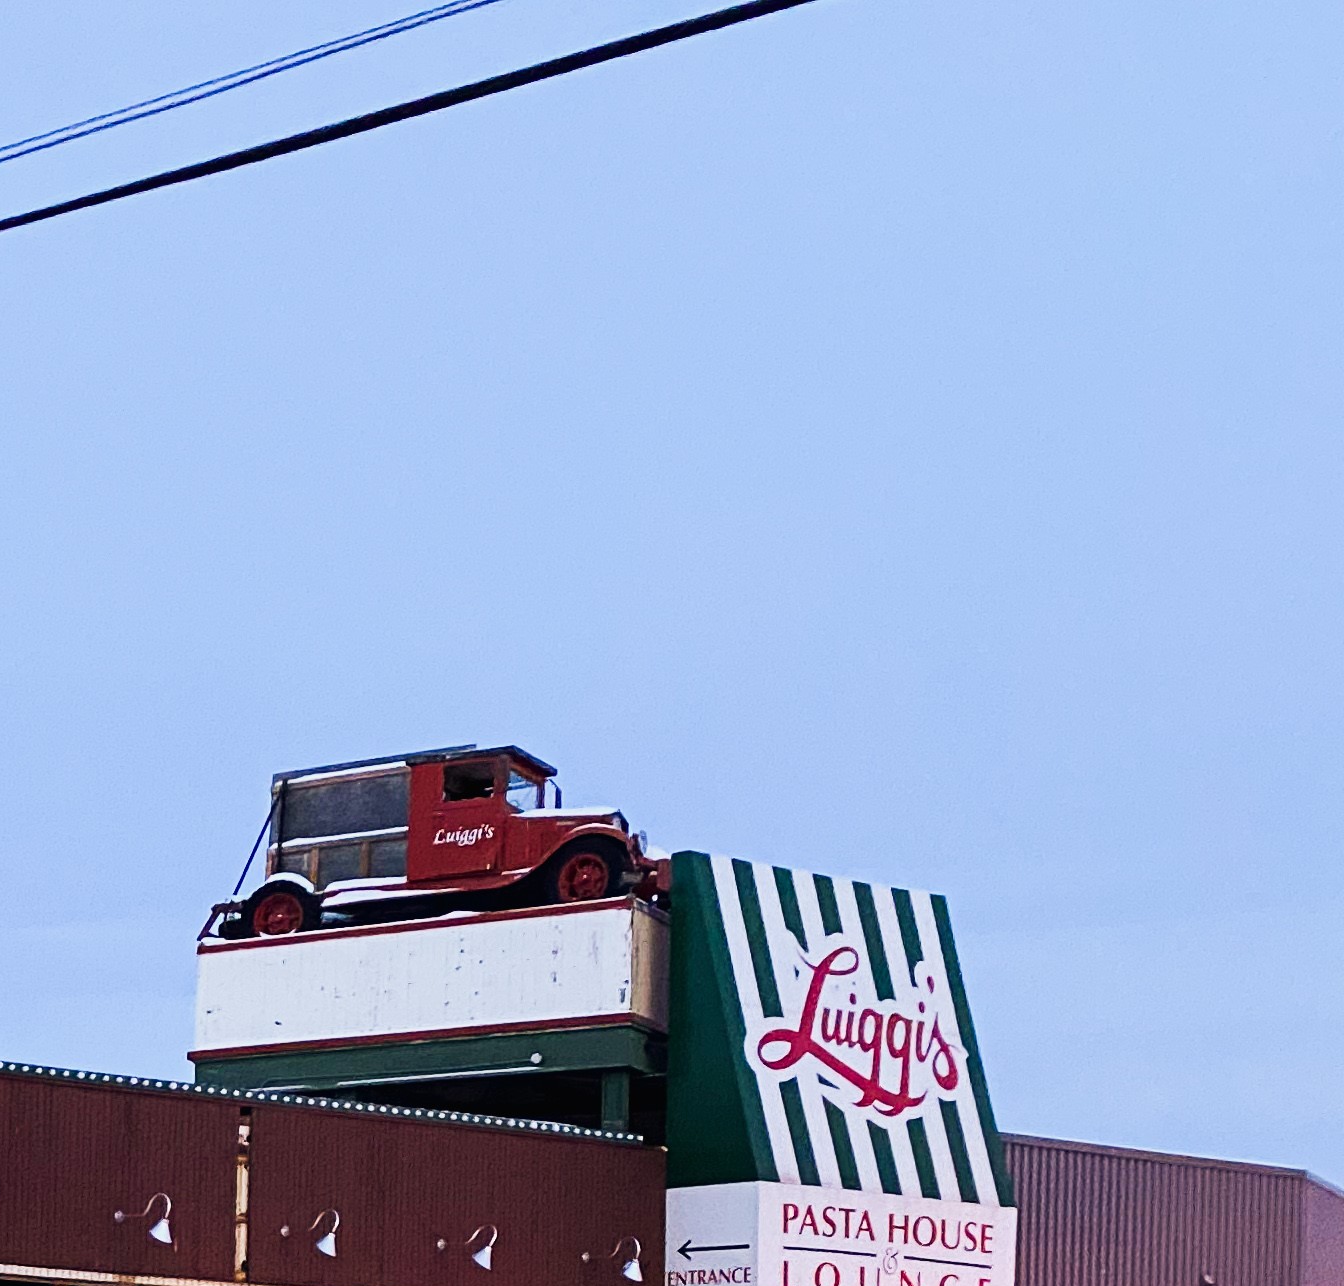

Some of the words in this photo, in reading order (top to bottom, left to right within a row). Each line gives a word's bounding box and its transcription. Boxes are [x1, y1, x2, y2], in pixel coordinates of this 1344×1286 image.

[433, 824, 495, 846] Luiggi's
[757, 947, 958, 1117] Luiggi's
[783, 1203, 875, 1241] PASTA
[888, 1213, 994, 1253] HOUSE
[882, 1248, 899, 1275] &
[667, 1267, 752, 1286] ENTRANCE
